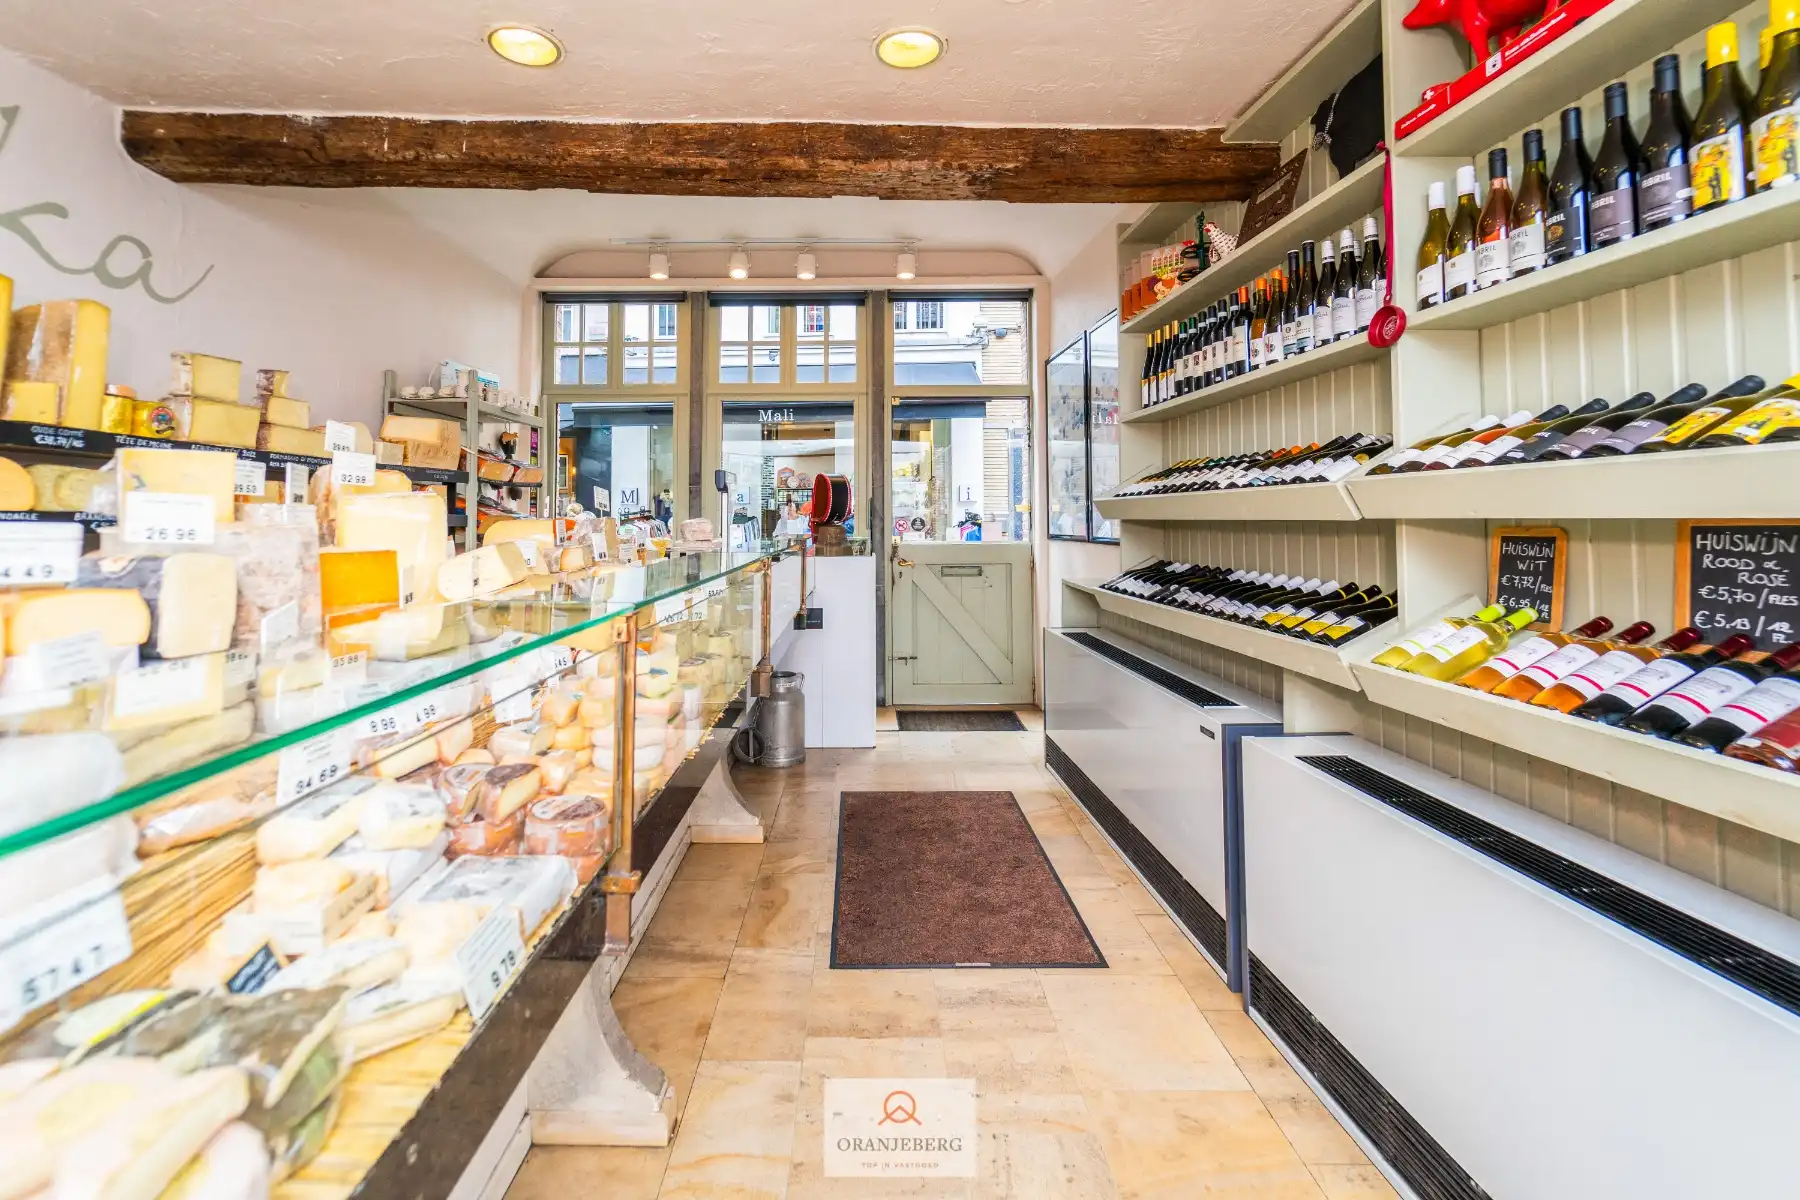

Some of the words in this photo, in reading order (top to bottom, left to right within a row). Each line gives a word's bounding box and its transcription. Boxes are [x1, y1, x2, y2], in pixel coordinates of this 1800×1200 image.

[758, 409, 795, 421] Mali
[115, 434, 136, 444] TÊTE
[621, 490, 638, 504] M
[1702, 553, 1756, 570] ROOD
